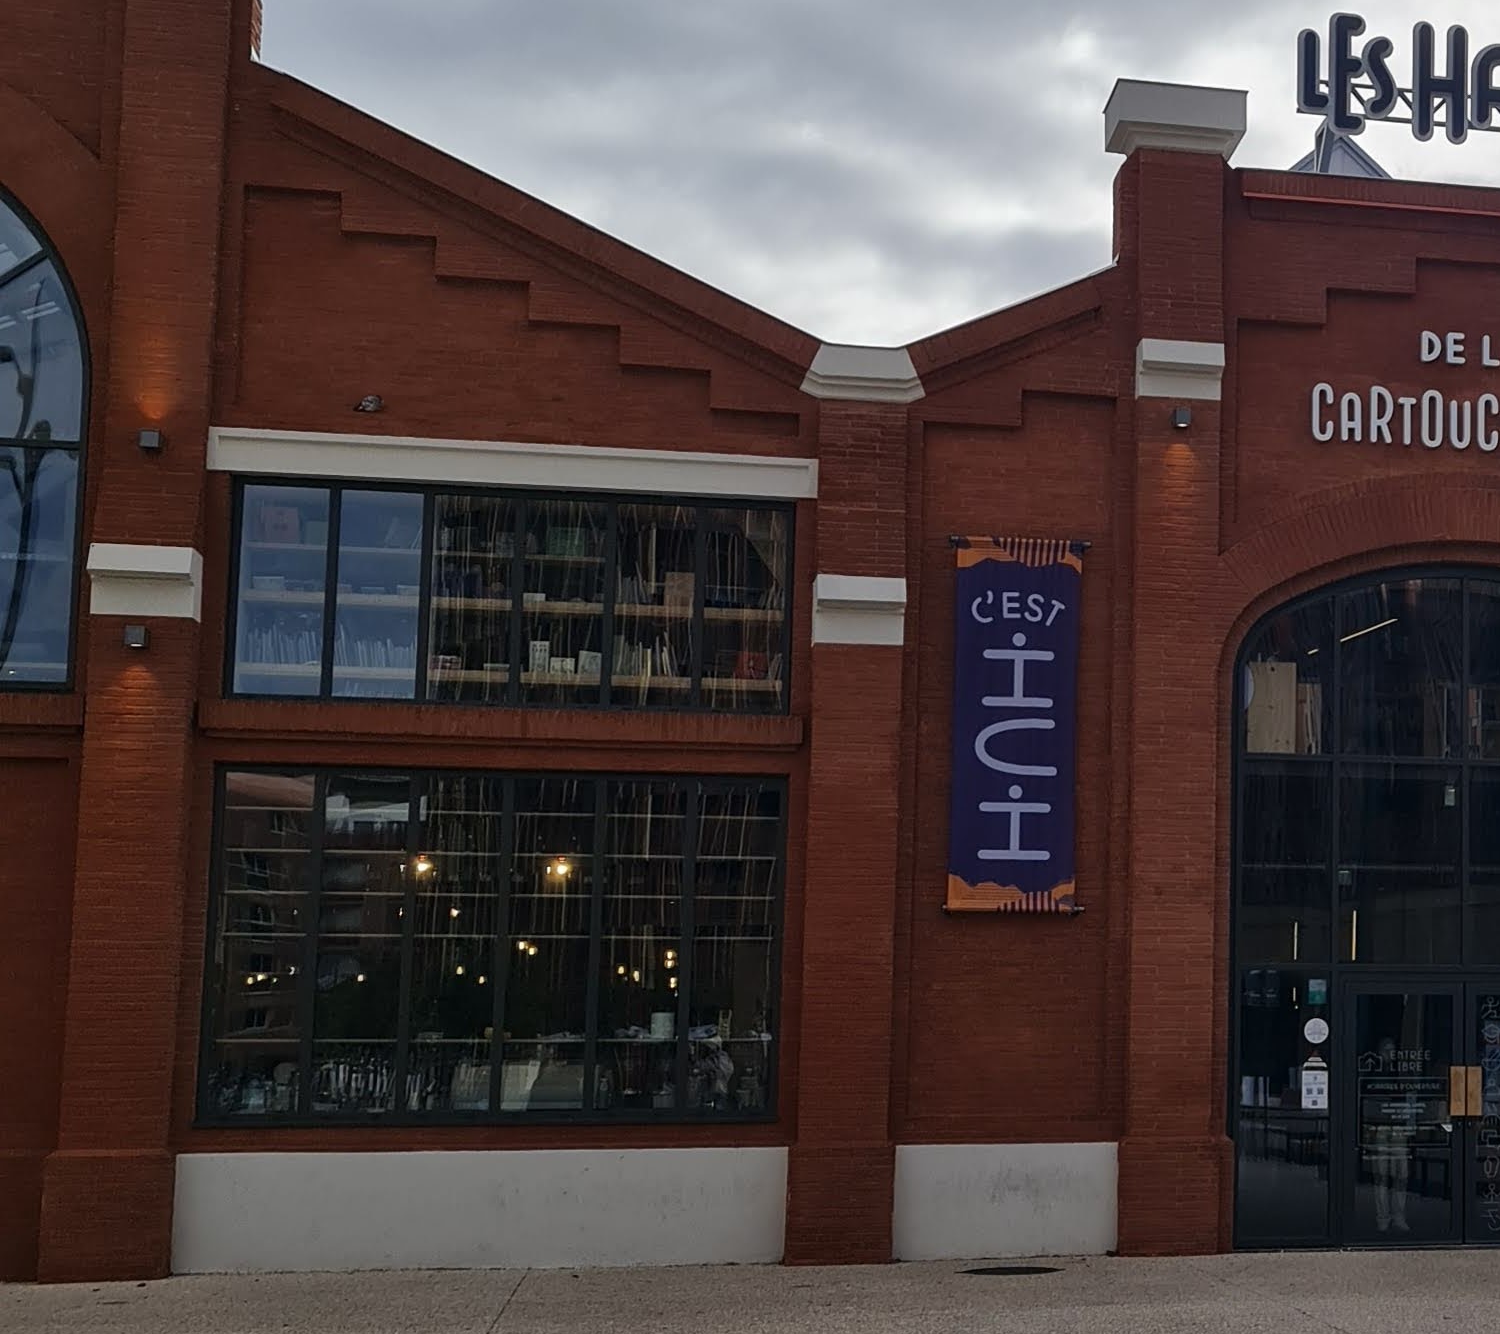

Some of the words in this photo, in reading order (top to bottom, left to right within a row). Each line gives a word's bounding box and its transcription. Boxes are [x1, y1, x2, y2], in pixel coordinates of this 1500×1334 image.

[1296, 11, 1398, 135] LES
[1419, 329, 1466, 365] DE
[971, 589, 1065, 627] C'EST
[1389, 1061, 1424, 1072] LIBRE
[1390, 1048, 1431, 1061] ENTRÉE
